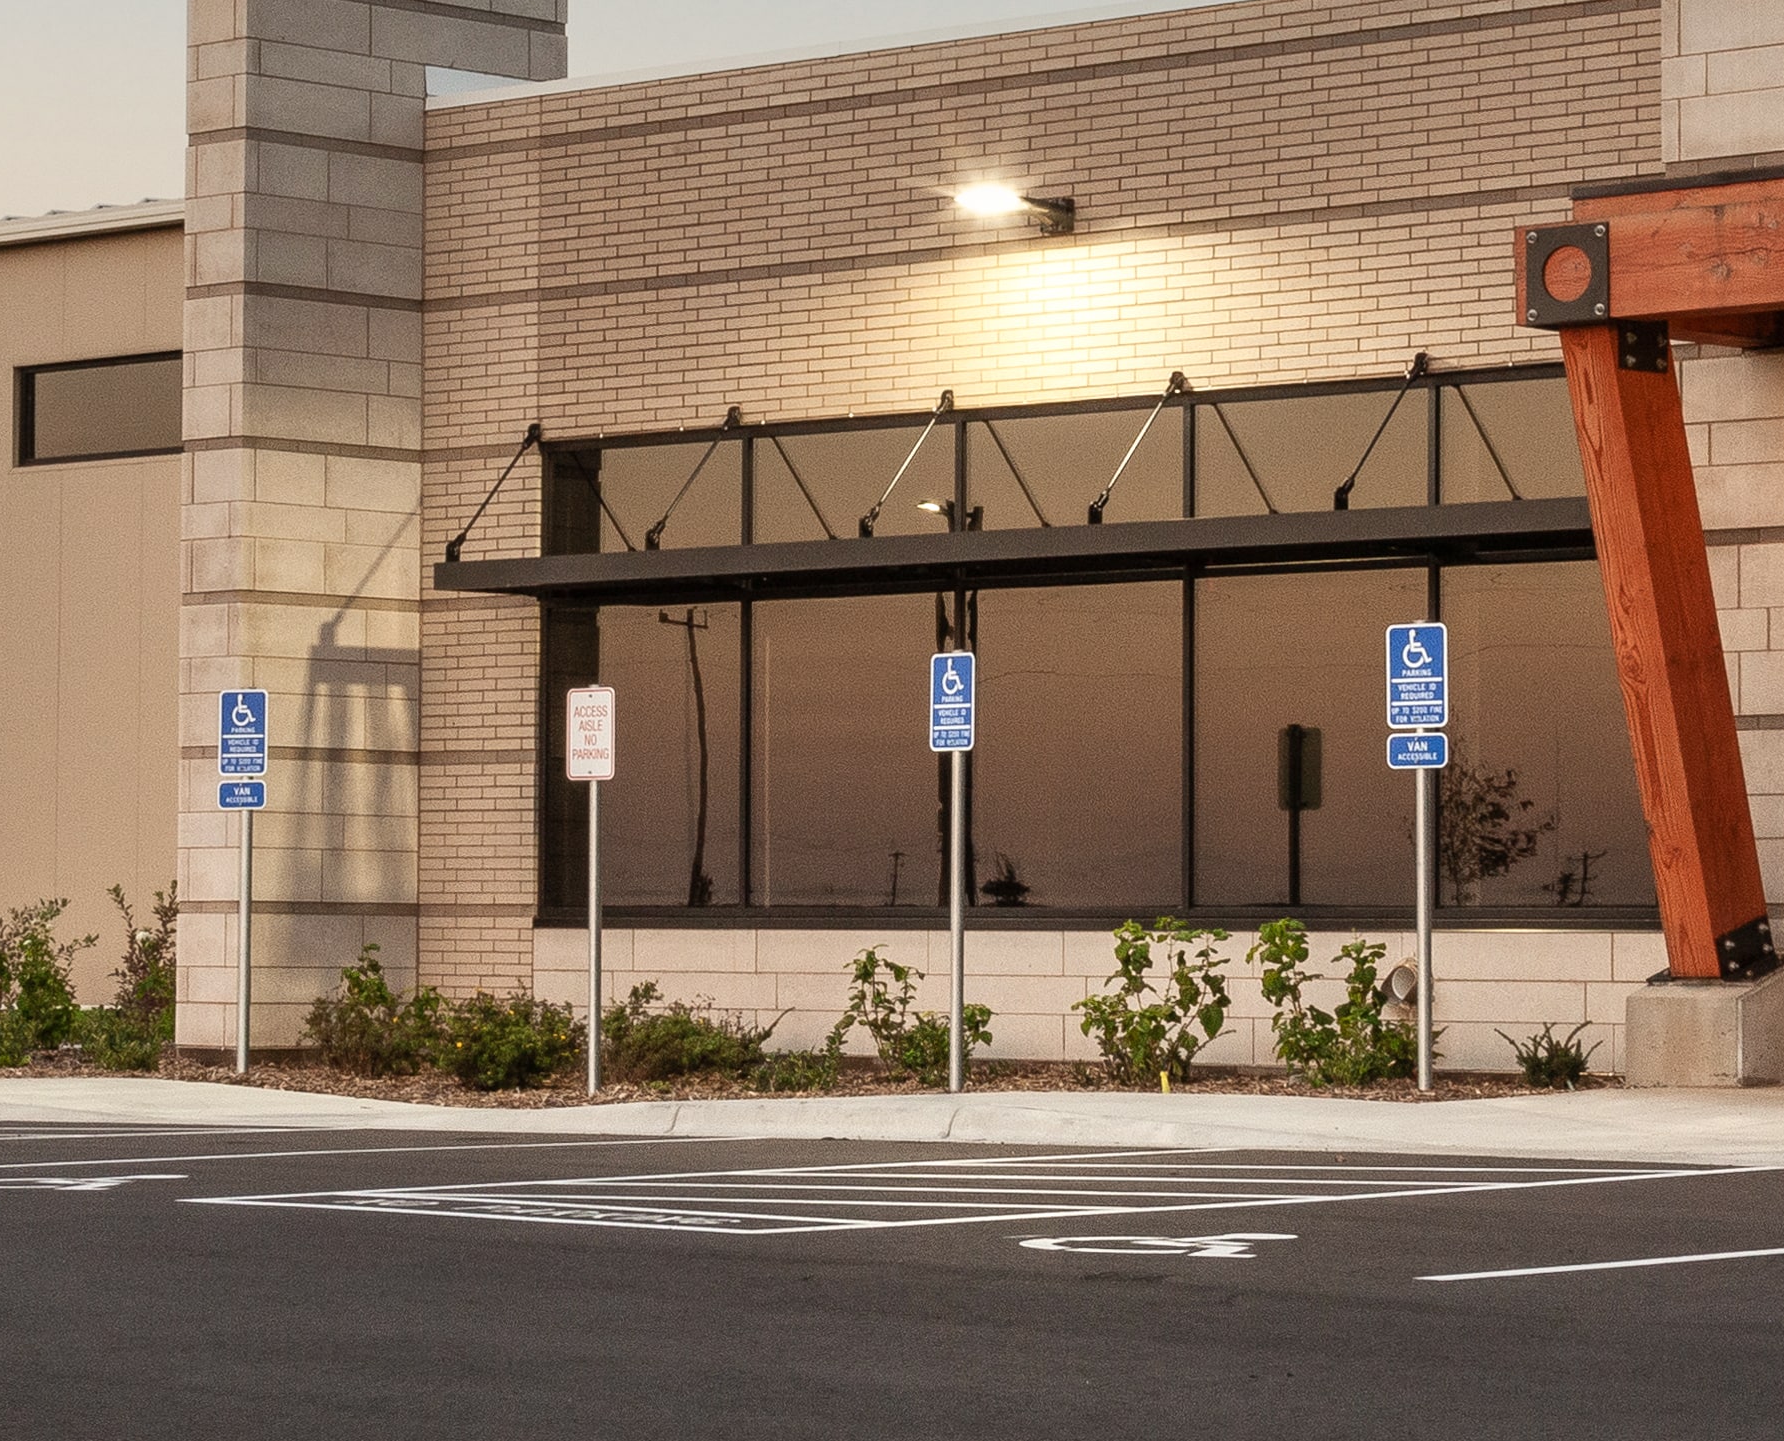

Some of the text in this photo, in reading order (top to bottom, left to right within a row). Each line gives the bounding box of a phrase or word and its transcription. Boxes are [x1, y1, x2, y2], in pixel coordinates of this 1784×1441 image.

[1402, 669, 1432, 677] PARKING
[1398, 684, 1426, 692] VEHICLE
[1401, 692, 1435, 700] REQUIRED
[574, 705, 608, 718] ACCESS
[578, 719, 603, 732] AISLE
[584, 734, 597, 746] NO
[1407, 741, 1428, 752] VAN
[572, 747, 610, 760] PARKING
[1398, 752, 1437, 761] ACCESSIBLE
[233, 787, 251, 796] VAN
